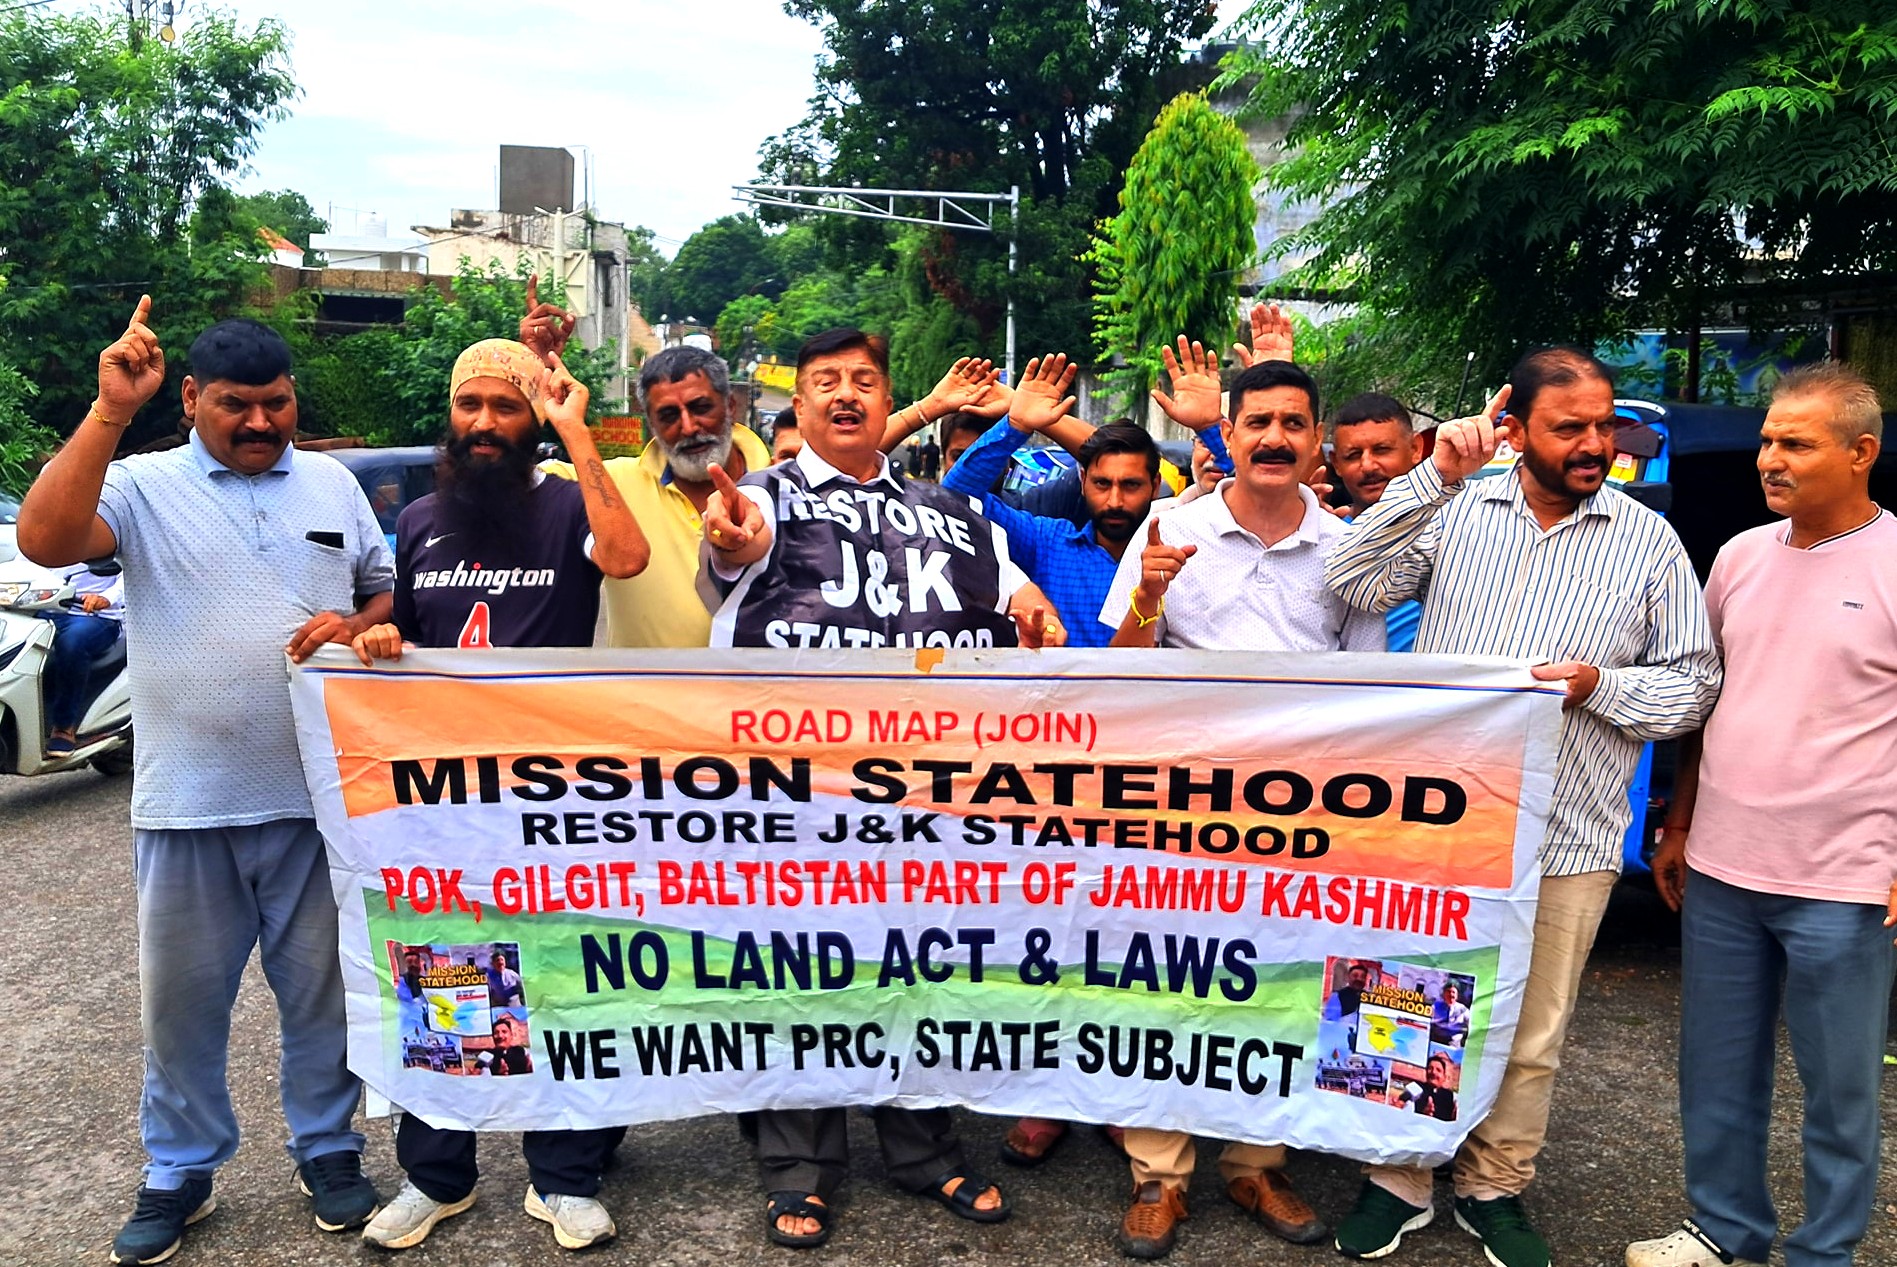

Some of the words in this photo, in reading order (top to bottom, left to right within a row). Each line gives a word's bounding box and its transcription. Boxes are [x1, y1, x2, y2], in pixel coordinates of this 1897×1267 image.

[778, 478, 975, 556] RESTORE
[413, 559, 555, 595] washington
[820, 540, 962, 617] J&K
[731, 709, 852, 743] ROAD
[868, 710, 959, 743] MAP
[974, 712, 1097, 751] (JOIN)
[391, 755, 812, 804] MISSION
[850, 757, 1467, 825] STATEHOOD
[521, 811, 798, 845] RESTORE
[817, 812, 942, 843] J&K
[961, 814, 1330, 859] STATEHOOD
[380, 866, 483, 923] POK,
[492, 862, 645, 917] GILGIT,
[658, 859, 887, 907] BALTISTAN
[903, 859, 1007, 905] PART
[1021, 861, 1077, 905] OF
[1089, 864, 1247, 914] JAMMU
[1261, 870, 1471, 940] KASHMIR
[419, 975, 488, 987] STATEHOOD
[429, 965, 476, 976] MISSION
[580, 929, 670, 994] NO
[690, 929, 855, 990] LAND
[877, 927, 996, 988] ACT
[1018, 927, 1061, 986] &
[1084, 929, 1258, 1001] LAWS
[1360, 992, 1432, 1016] STATEHOOD
[1372, 984, 1424, 1002] MISSION
[543, 1028, 621, 1081] WE
[631, 1022, 774, 1077] WANT
[791, 1021, 901, 1082] PRC,
[916, 1017, 1061, 1072] STATE
[1076, 1022, 1304, 1098] SUBJECT
